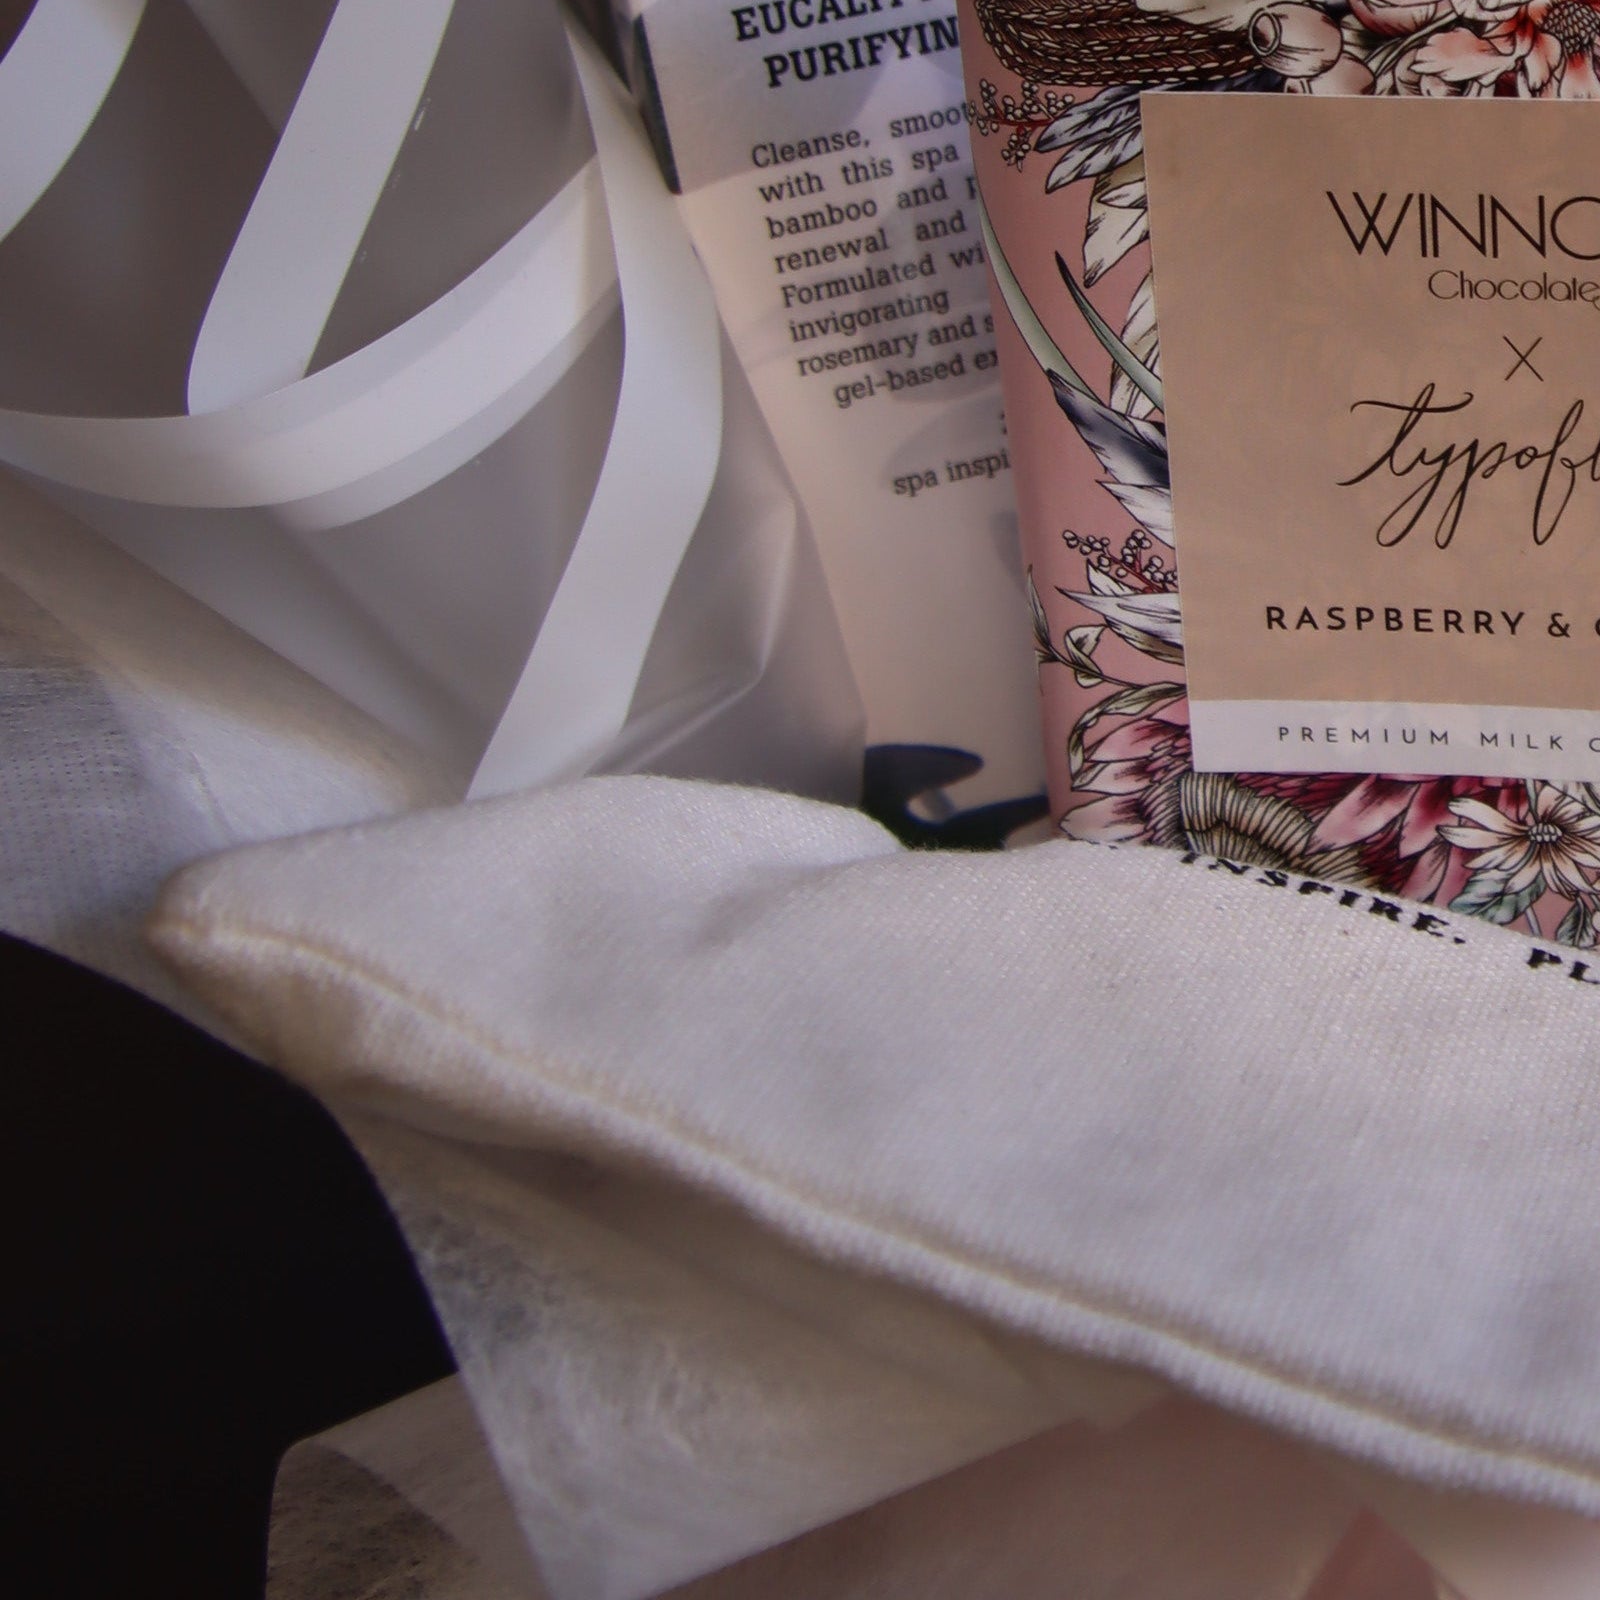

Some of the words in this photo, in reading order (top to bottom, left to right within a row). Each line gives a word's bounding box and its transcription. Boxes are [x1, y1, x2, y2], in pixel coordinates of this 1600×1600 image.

[752, 128, 870, 168] Cleanse,
[759, 171, 825, 203] with
[841, 155, 893, 187] this
[911, 143, 960, 172] spa
[766, 198, 877, 240] bamboo
[897, 177, 948, 210] and
[775, 228, 889, 274] renewal
[915, 209, 966, 242] and
[781, 253, 935, 308] Formulated
[789, 288, 949, 343] invigorating
[798, 332, 918, 377] rosemary
[928, 314, 977, 347] and
[833, 353, 966, 410] gel-based
[893, 469, 938, 497] spa
[1265, 605, 1526, 637] RASPBERRY
[1547, 613, 1572, 638] &
[1278, 726, 1450, 746] PREMIUM
[1480, 732, 1564, 752] MILK
